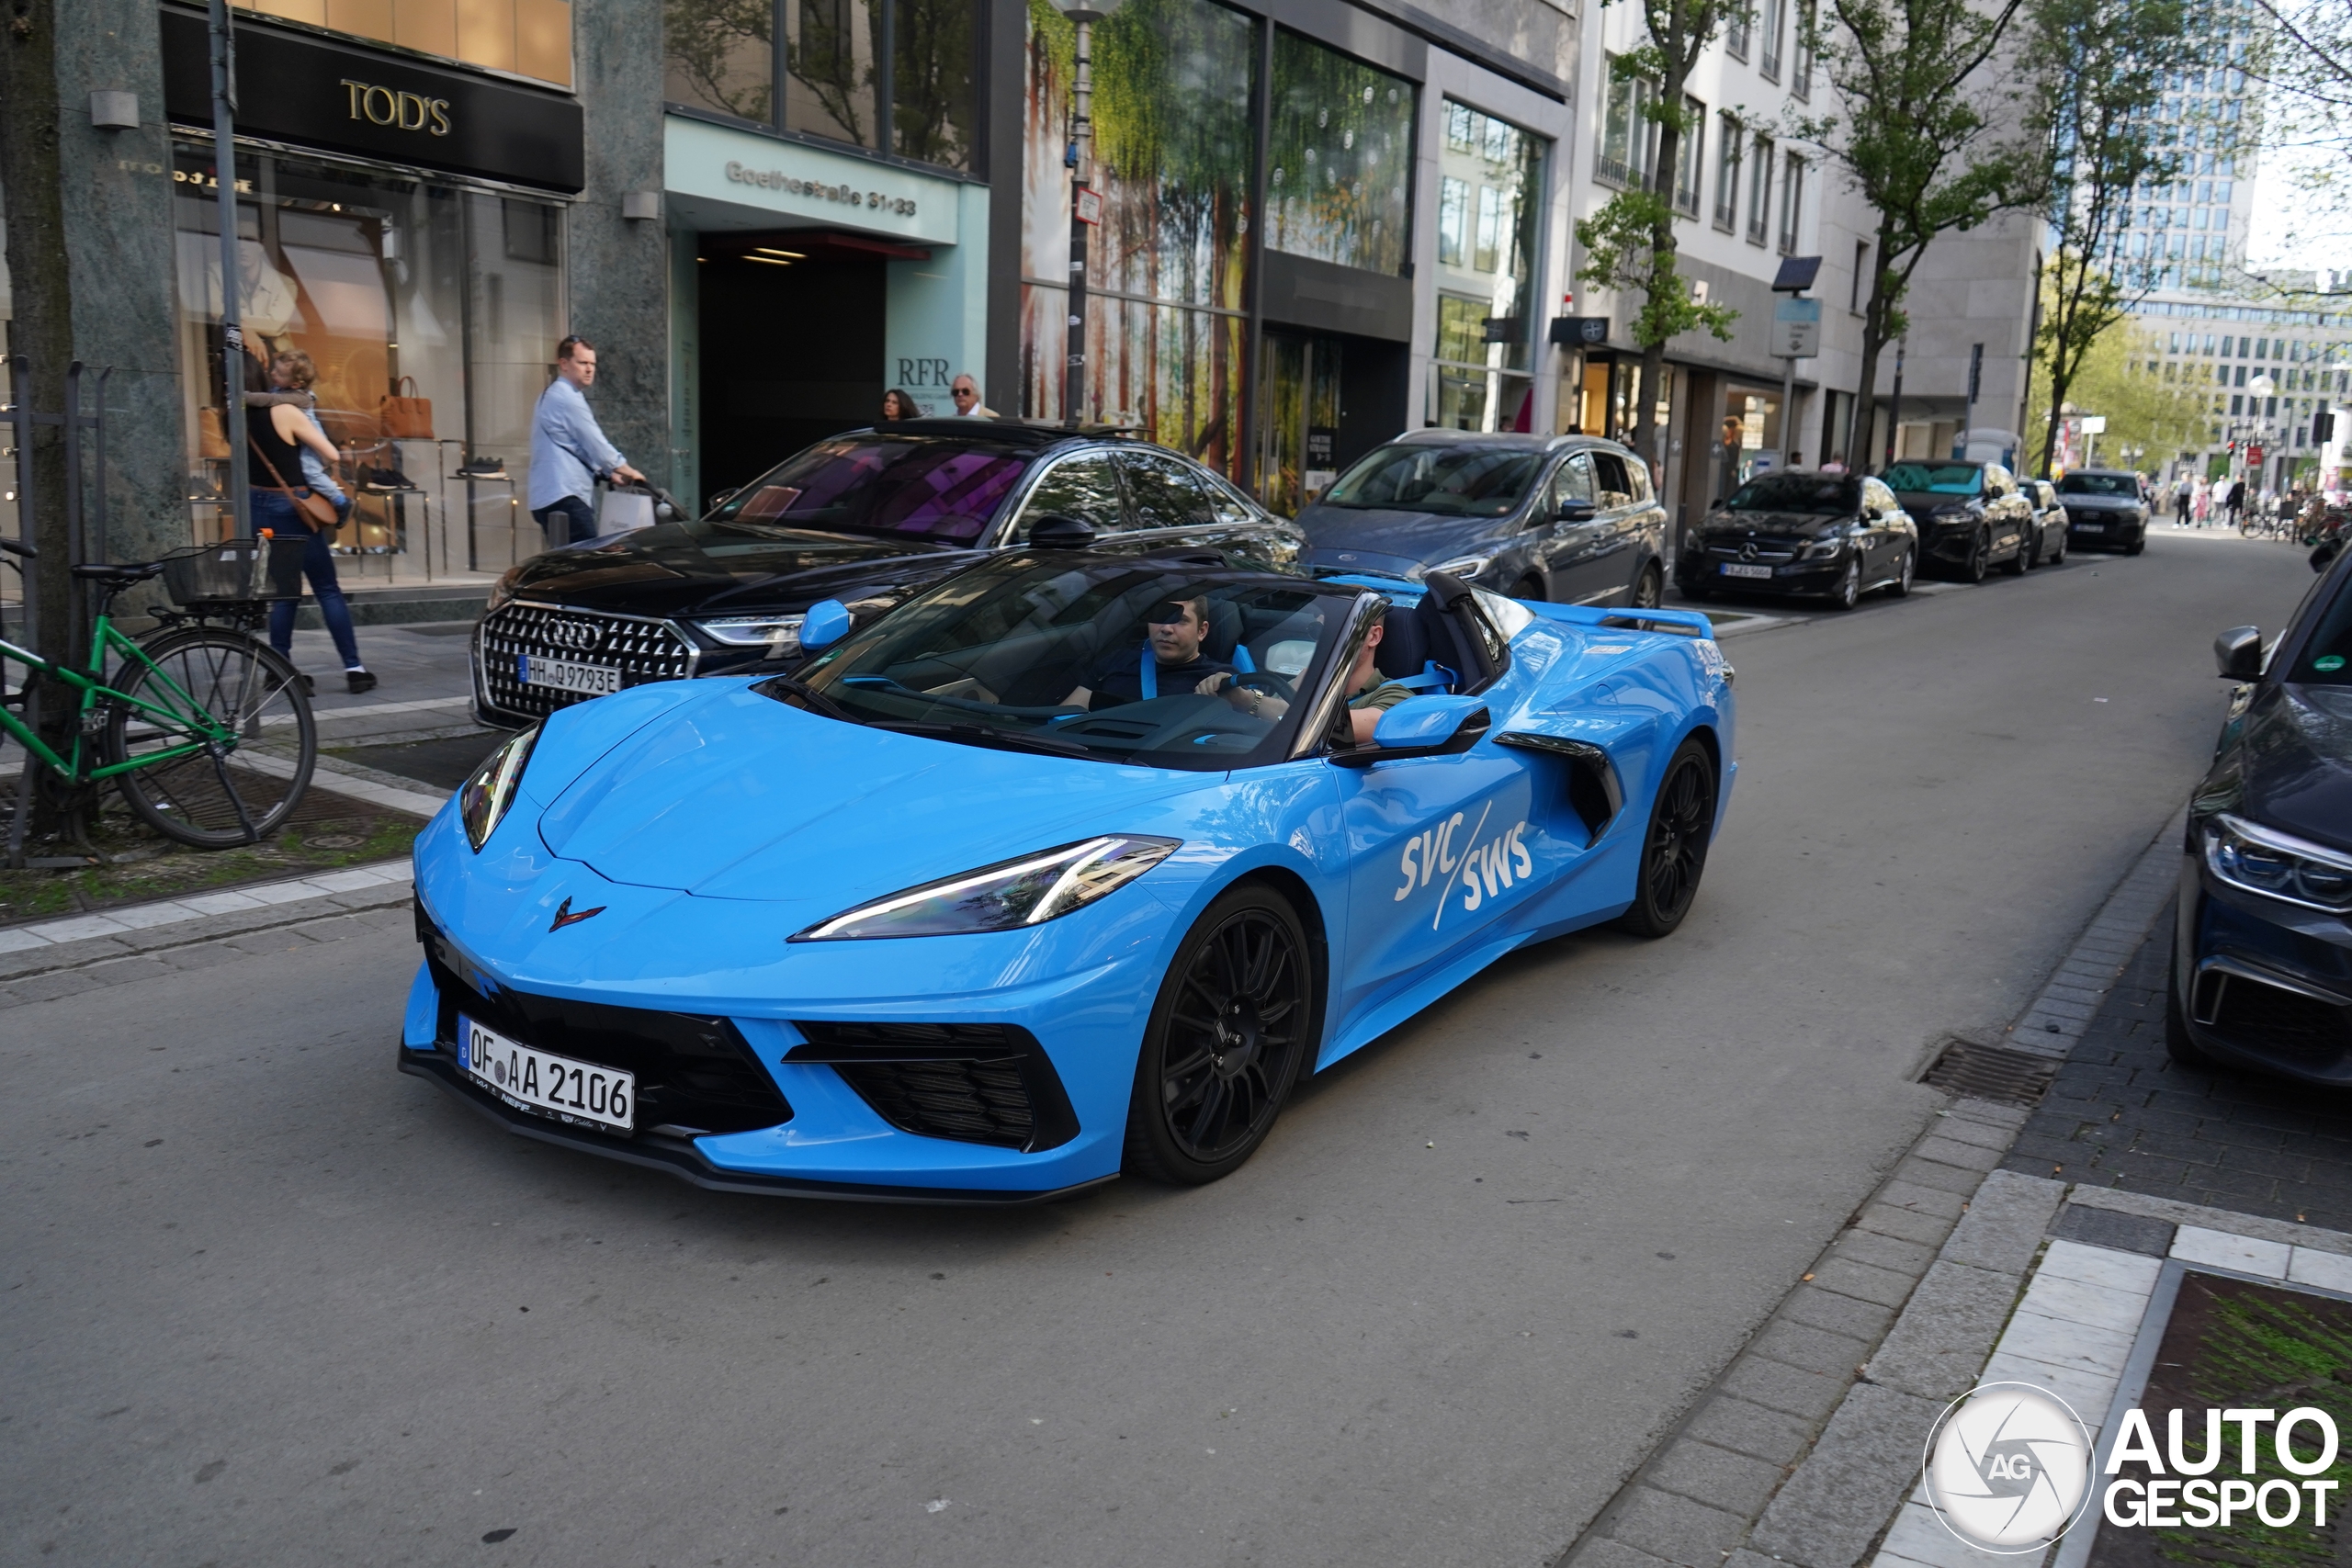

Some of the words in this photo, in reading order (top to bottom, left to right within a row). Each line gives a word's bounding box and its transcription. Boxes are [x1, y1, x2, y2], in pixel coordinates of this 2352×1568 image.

[340, 78, 452, 137] TOD'S
[726, 160, 862, 205] Goethestraße
[897, 358, 950, 386] RFR
[528, 659, 547, 682] HH
[471, 1029, 494, 1073] OF
[508, 1050, 538, 1098] AA
[548, 1063, 627, 1119] 2106
[501, 1092, 530, 1111] NEFF
